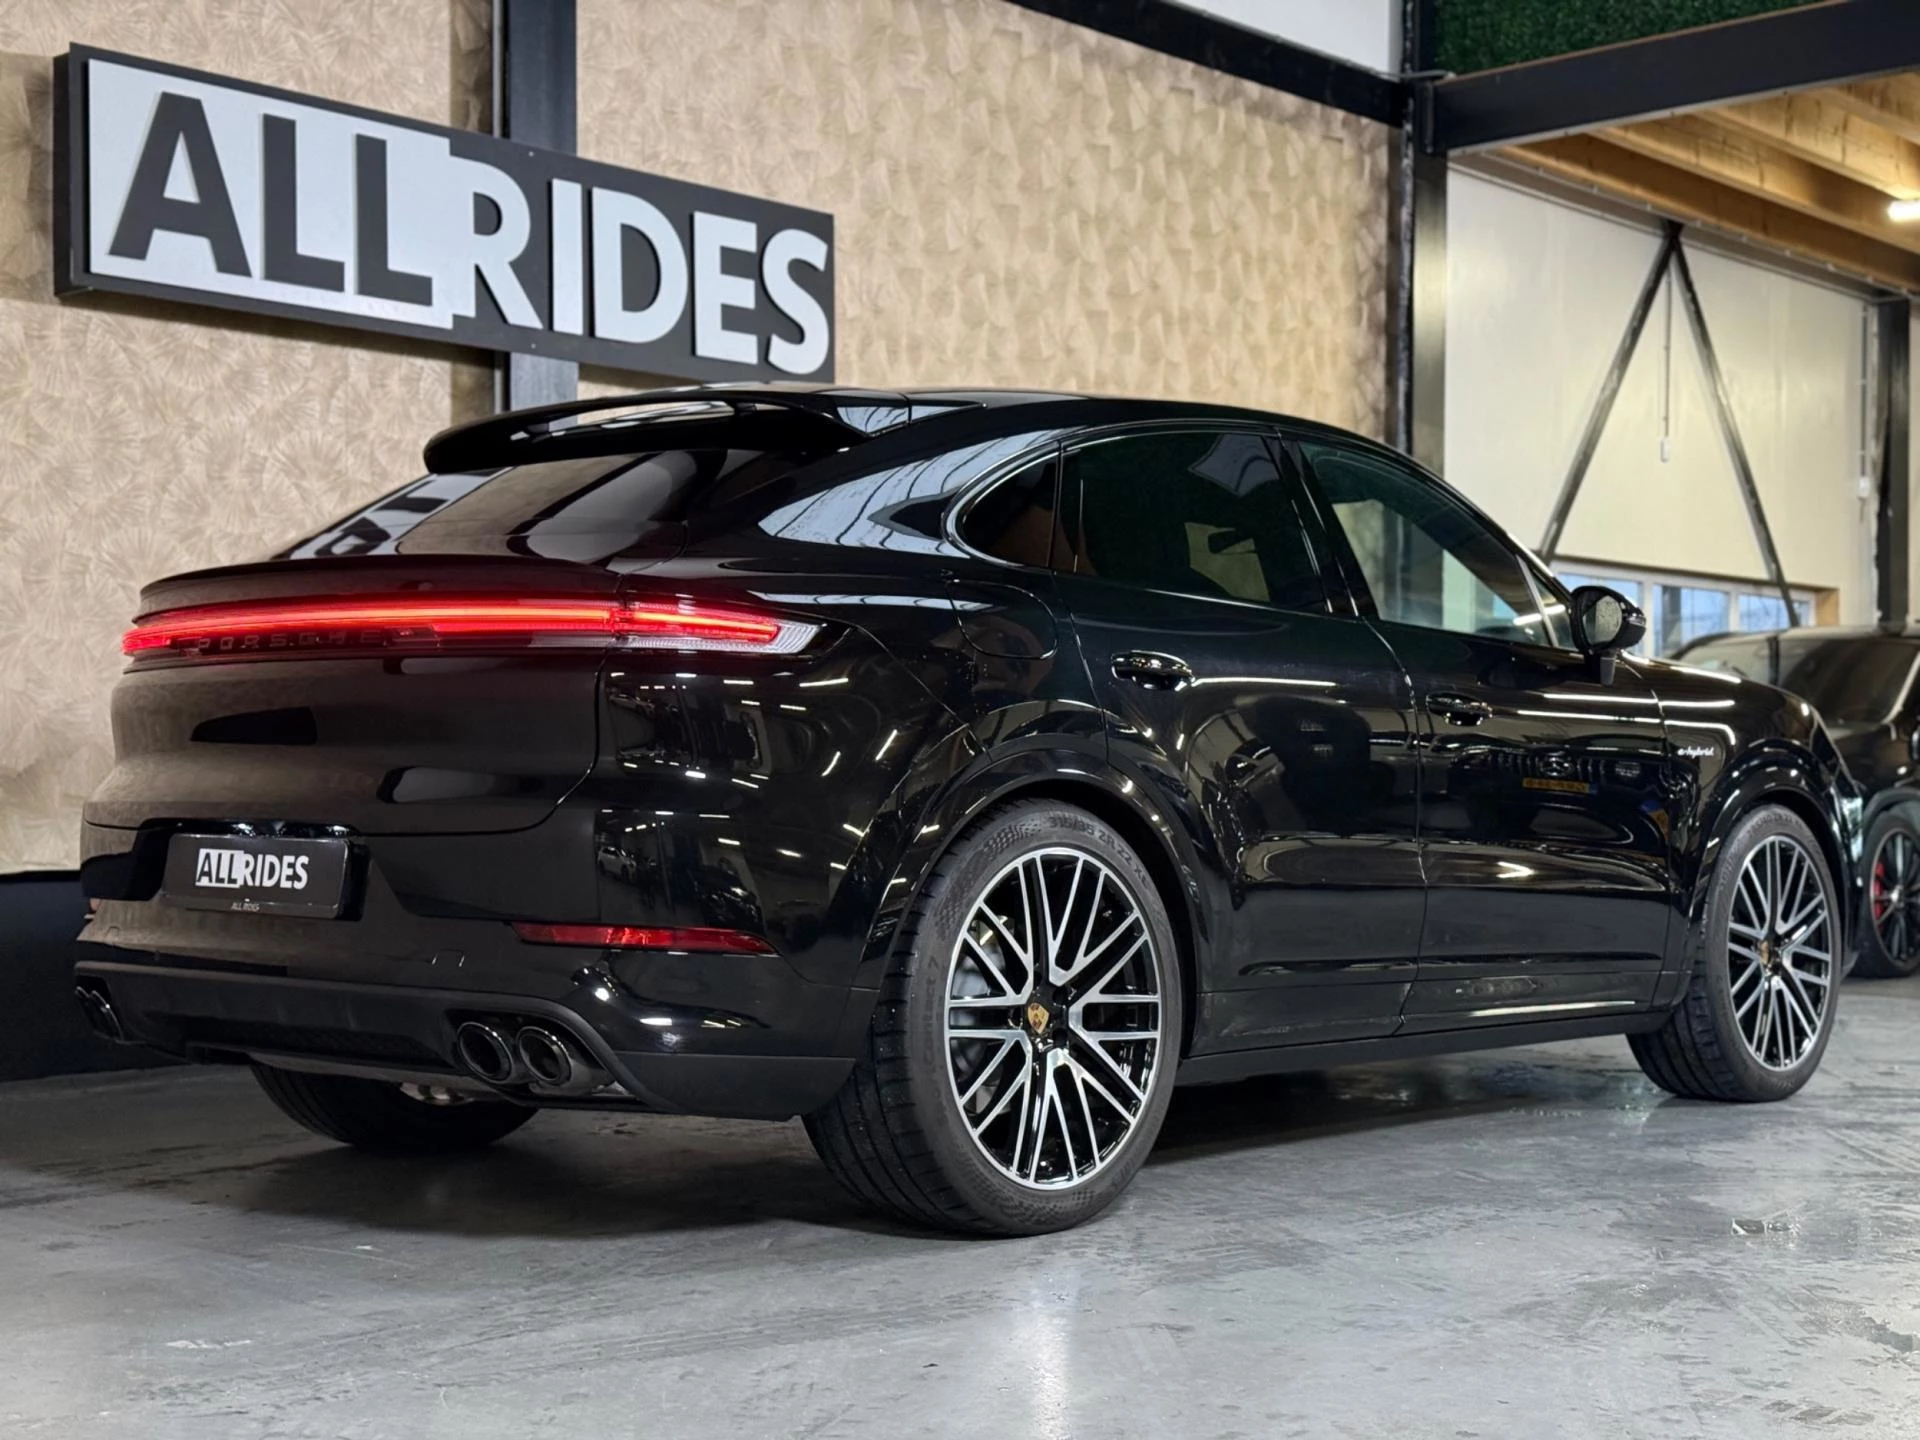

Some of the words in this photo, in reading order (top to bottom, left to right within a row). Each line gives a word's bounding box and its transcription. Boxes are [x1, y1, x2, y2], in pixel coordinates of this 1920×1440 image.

[106, 91, 830, 374] ALLRIDES
[196, 848, 310, 890] ALLRIDES
[1116, 843, 1133, 866] 22
